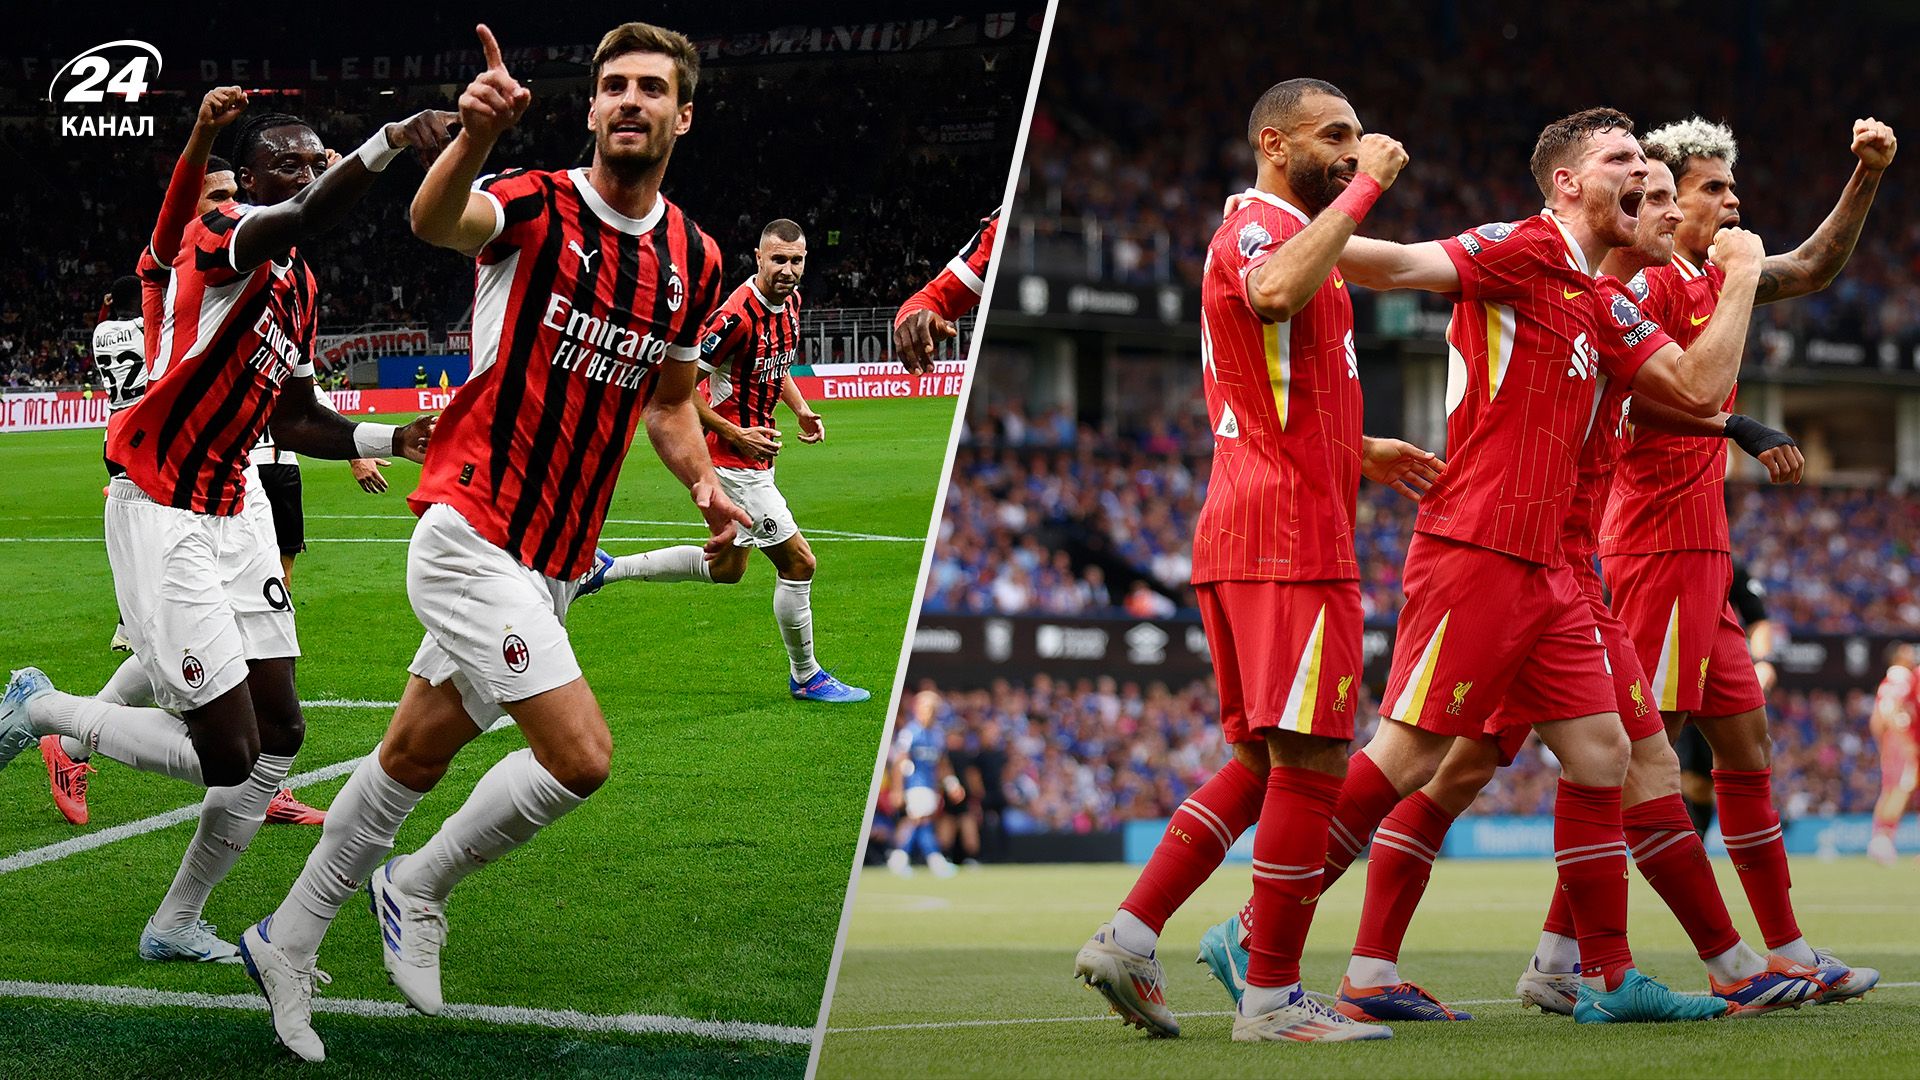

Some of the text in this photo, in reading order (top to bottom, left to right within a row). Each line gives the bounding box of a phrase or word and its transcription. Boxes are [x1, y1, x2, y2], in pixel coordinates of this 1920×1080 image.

[201, 58, 271, 82] DEI
[543, 292, 672, 364] Emirates
[96, 329, 132, 348] DUNCAN
[552, 341, 649, 390] FLY BETTER
[823, 375, 963, 399] Emirates FLY BE
[1333, 702, 1346, 712] LFC
[1446, 705, 1461, 716] LFC
[1635, 706, 1650, 718] LFC
[1170, 825, 1192, 844] LFC
